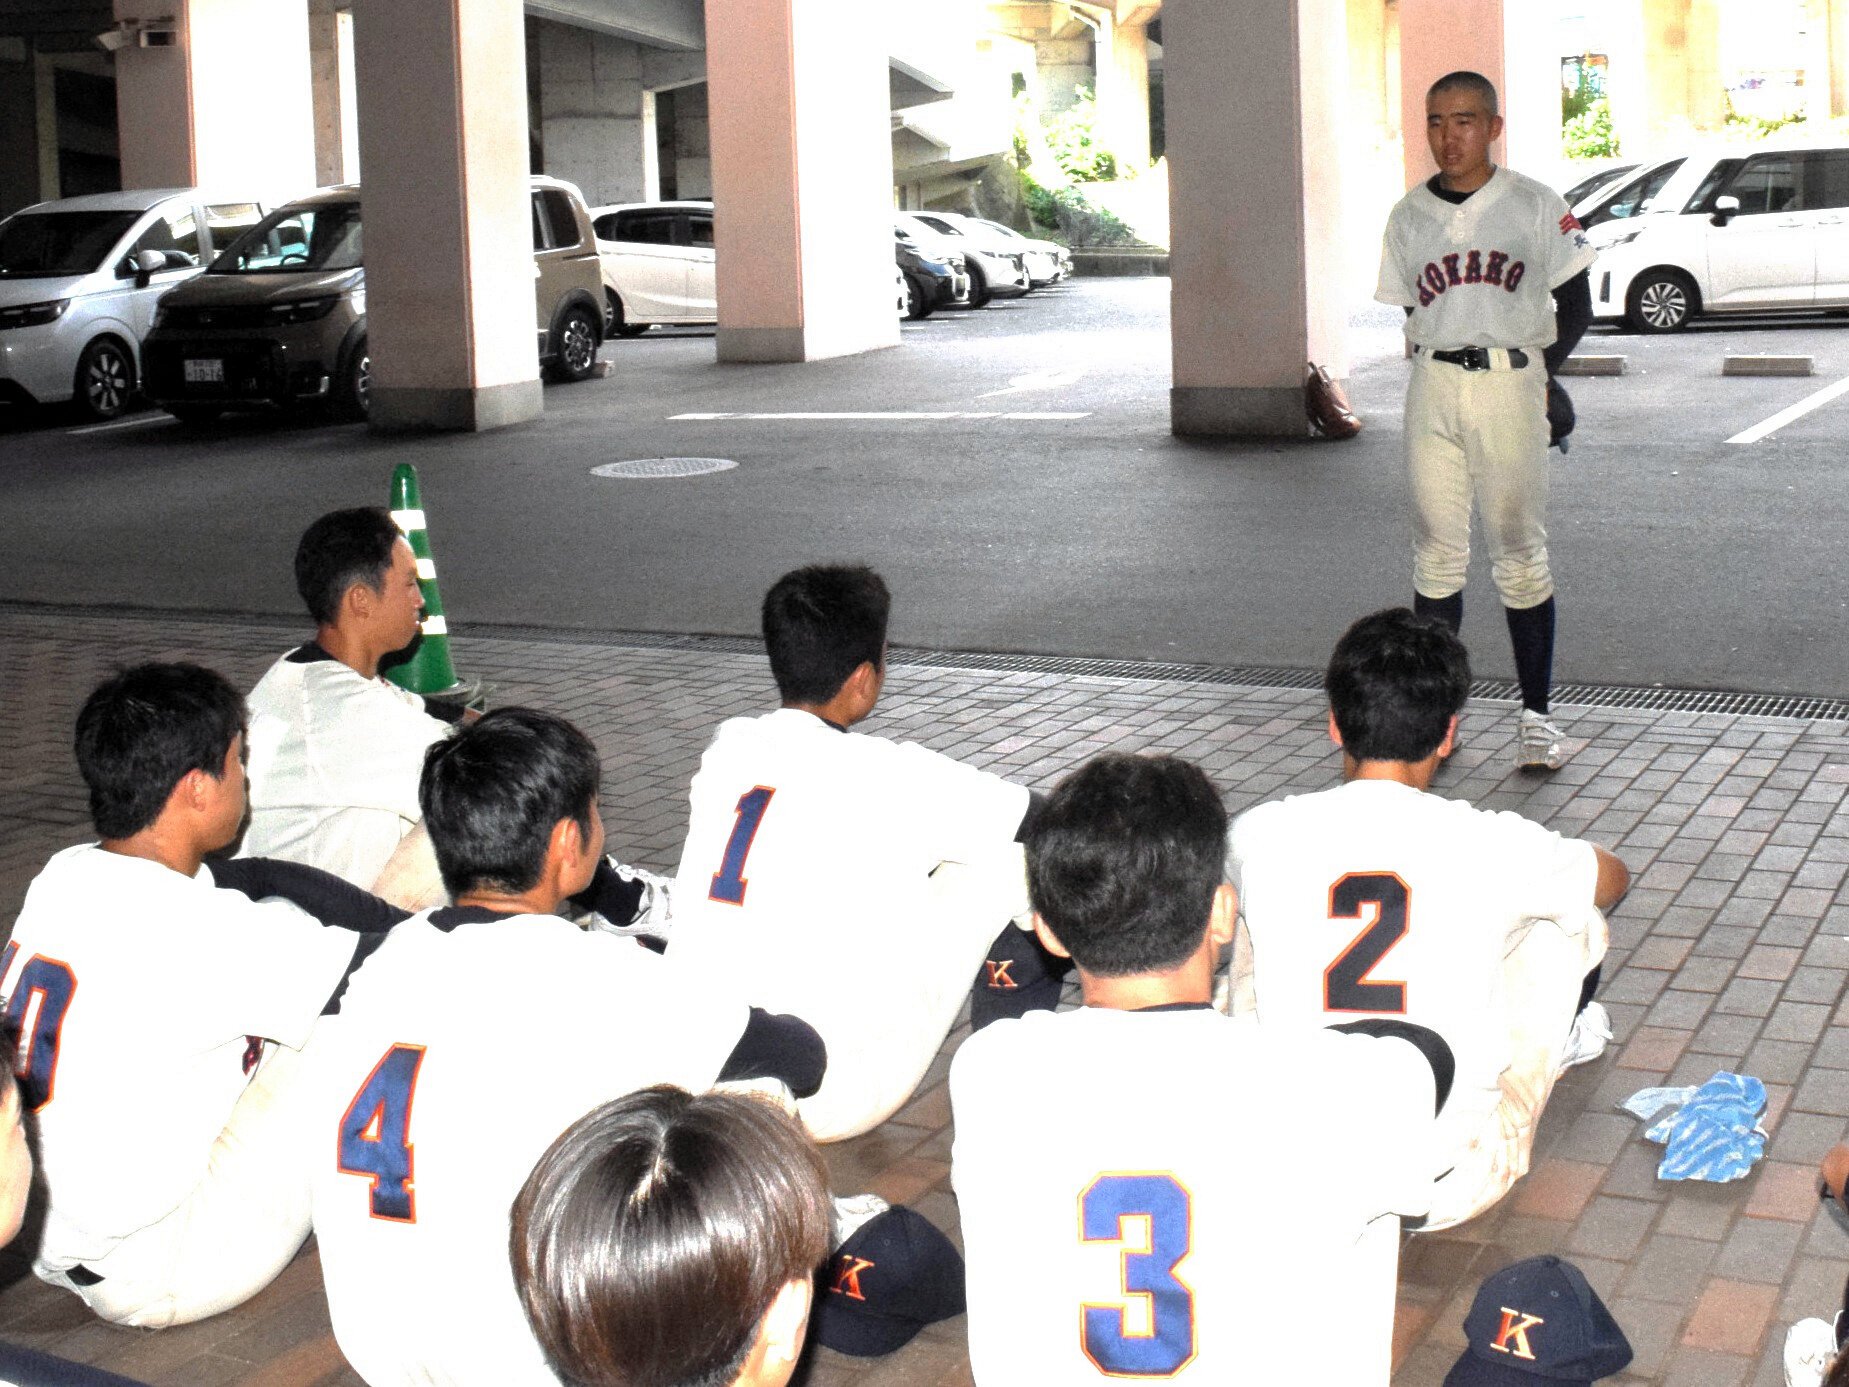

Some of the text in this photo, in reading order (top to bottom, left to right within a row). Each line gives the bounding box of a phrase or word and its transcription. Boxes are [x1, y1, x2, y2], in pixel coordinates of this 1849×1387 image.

[708, 784, 776, 907] 1
[986, 959, 1018, 987] K
[1323, 871, 1412, 1014] 2
[337, 1042, 428, 1224] 4
[829, 1254, 875, 1301] K
[1077, 1170, 1199, 1379] 3
[1489, 1306, 1544, 1360] K
